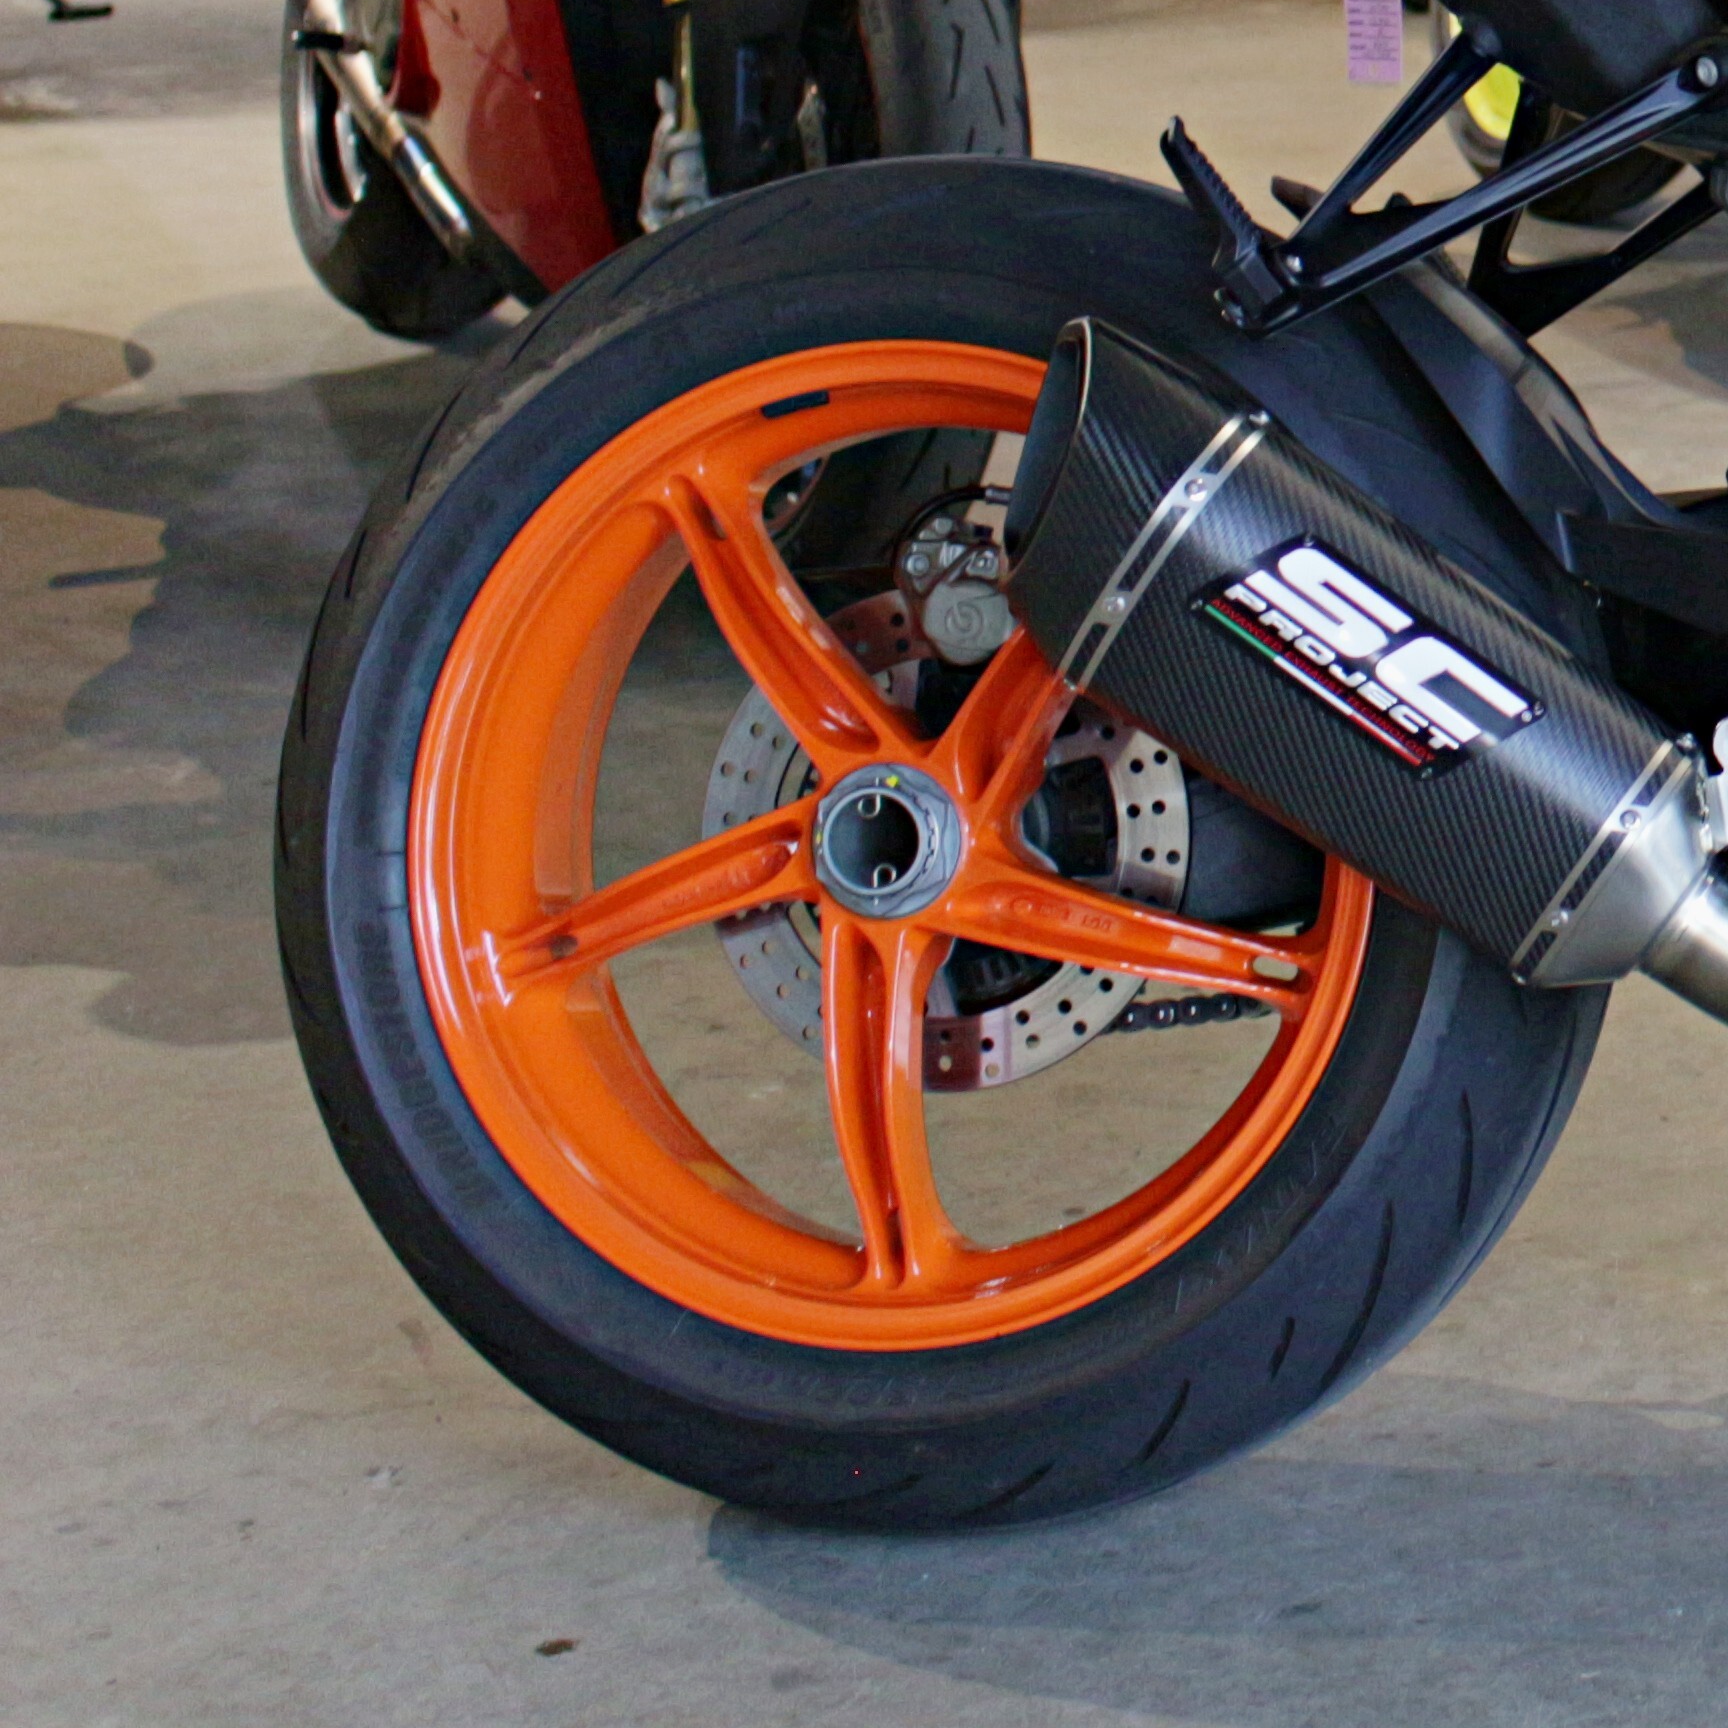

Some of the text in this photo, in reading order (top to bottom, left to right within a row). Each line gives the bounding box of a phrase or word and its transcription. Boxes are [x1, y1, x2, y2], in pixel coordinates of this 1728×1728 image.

[1209, 597, 1283, 653] ADVANCED
[1344, 695, 1436, 763] TECHNOLOGY
[1223, 583, 1460, 751] PROJECT
[1244, 547, 1530, 745] SC
